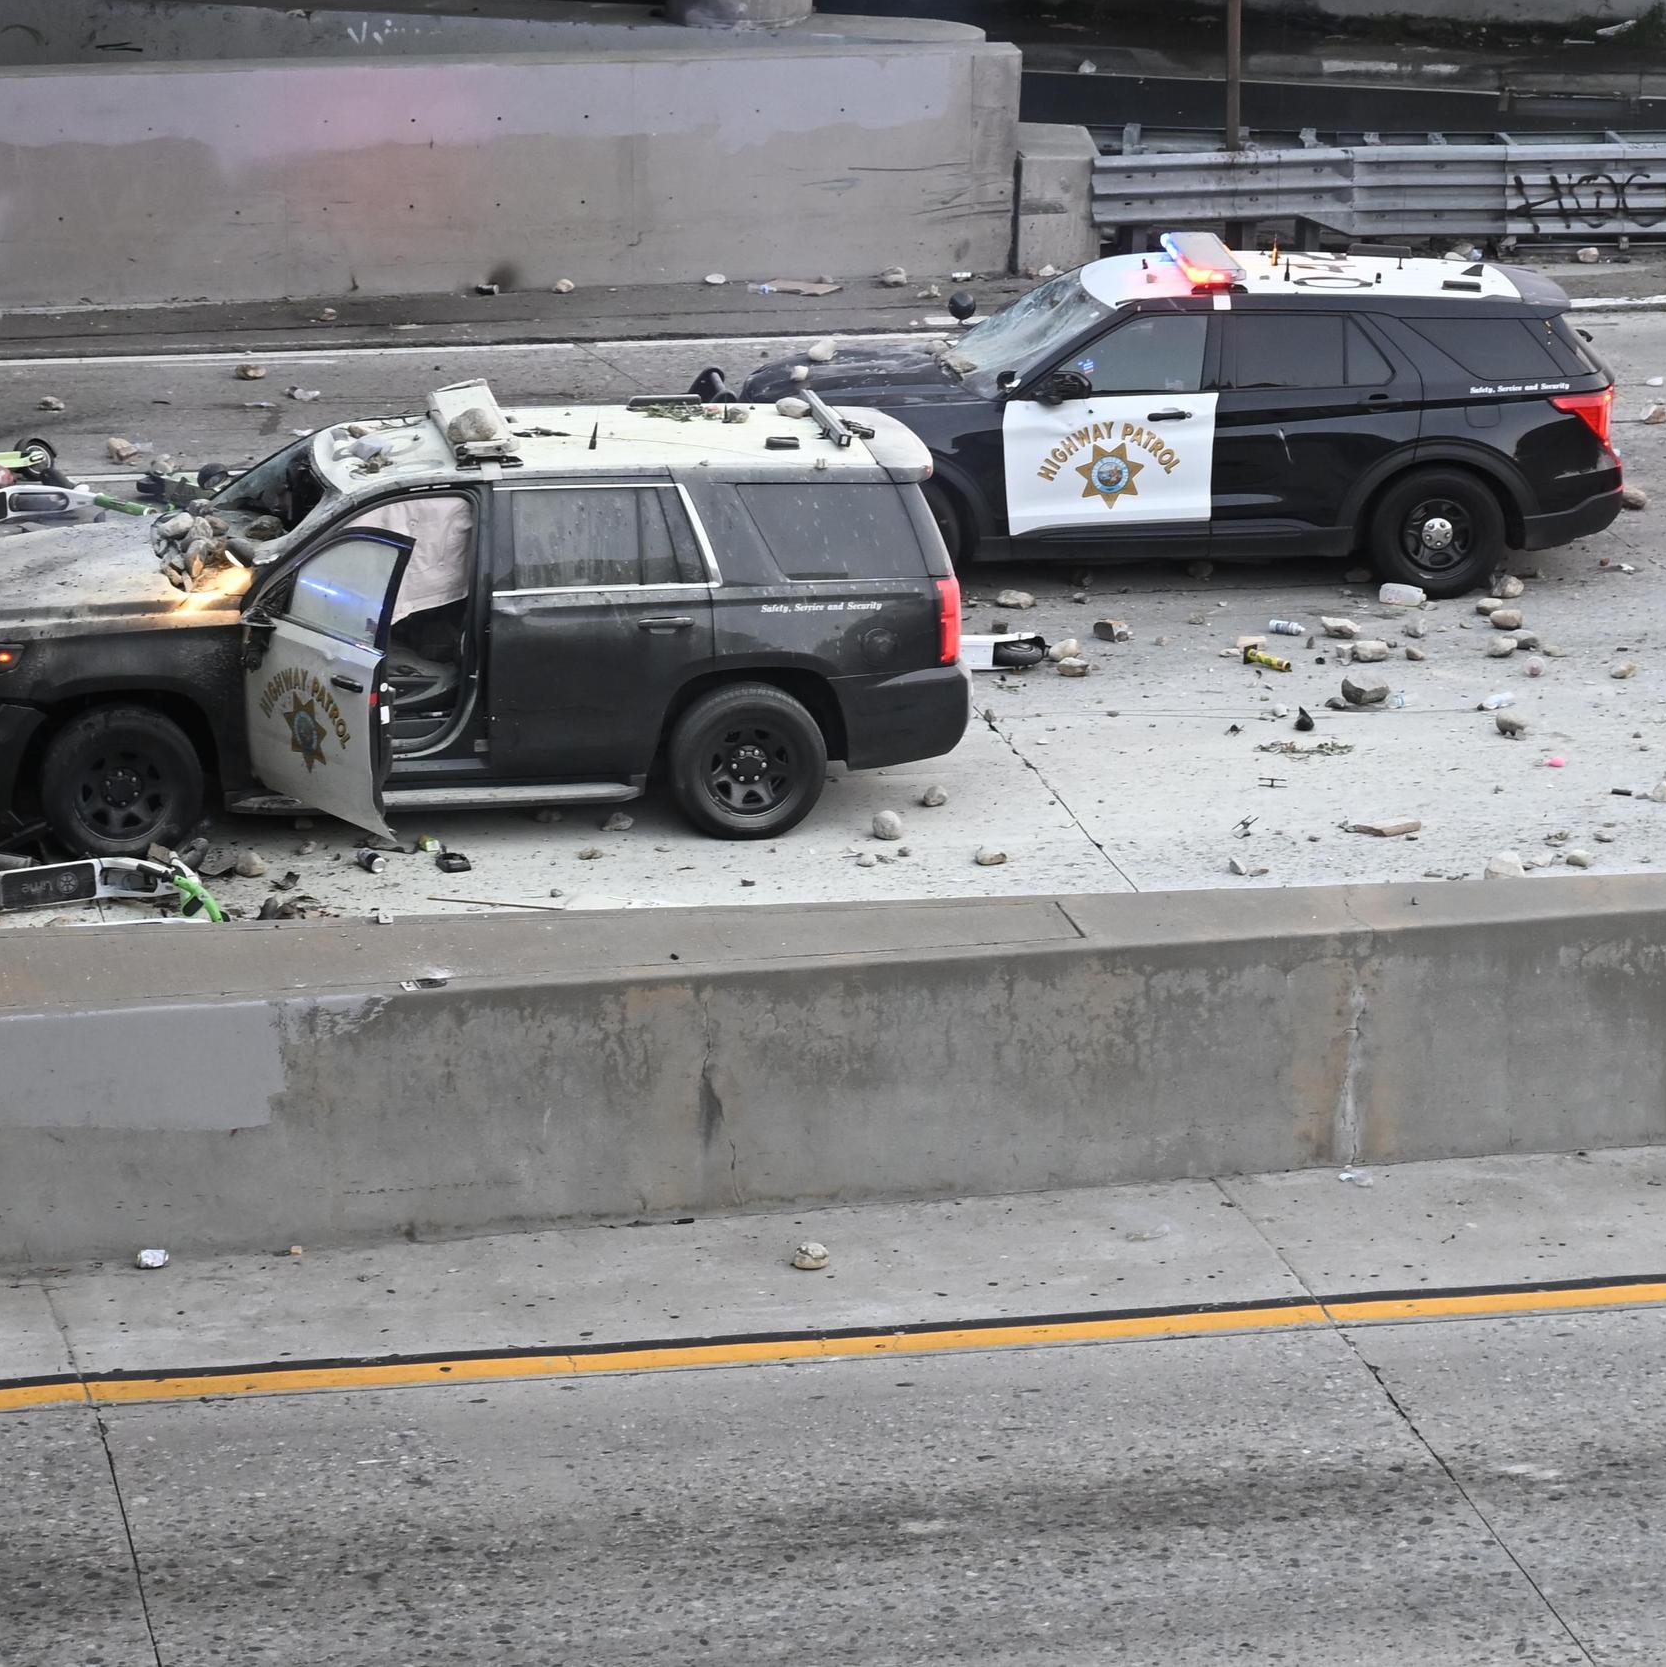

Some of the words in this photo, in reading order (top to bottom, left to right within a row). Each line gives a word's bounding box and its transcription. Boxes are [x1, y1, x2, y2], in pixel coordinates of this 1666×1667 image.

[1524, 383, 1538, 391] and
[1036, 421, 1115, 482] HIGHWAY
[1121, 422, 1181, 474] PATROL
[760, 604, 792, 614] Safety,
[794, 603, 825, 613] Service
[827, 602, 844, 611] and
[846, 601, 883, 611] Security
[259, 667, 309, 719] HIGHWAY
[311, 676, 351, 750] PATROL
